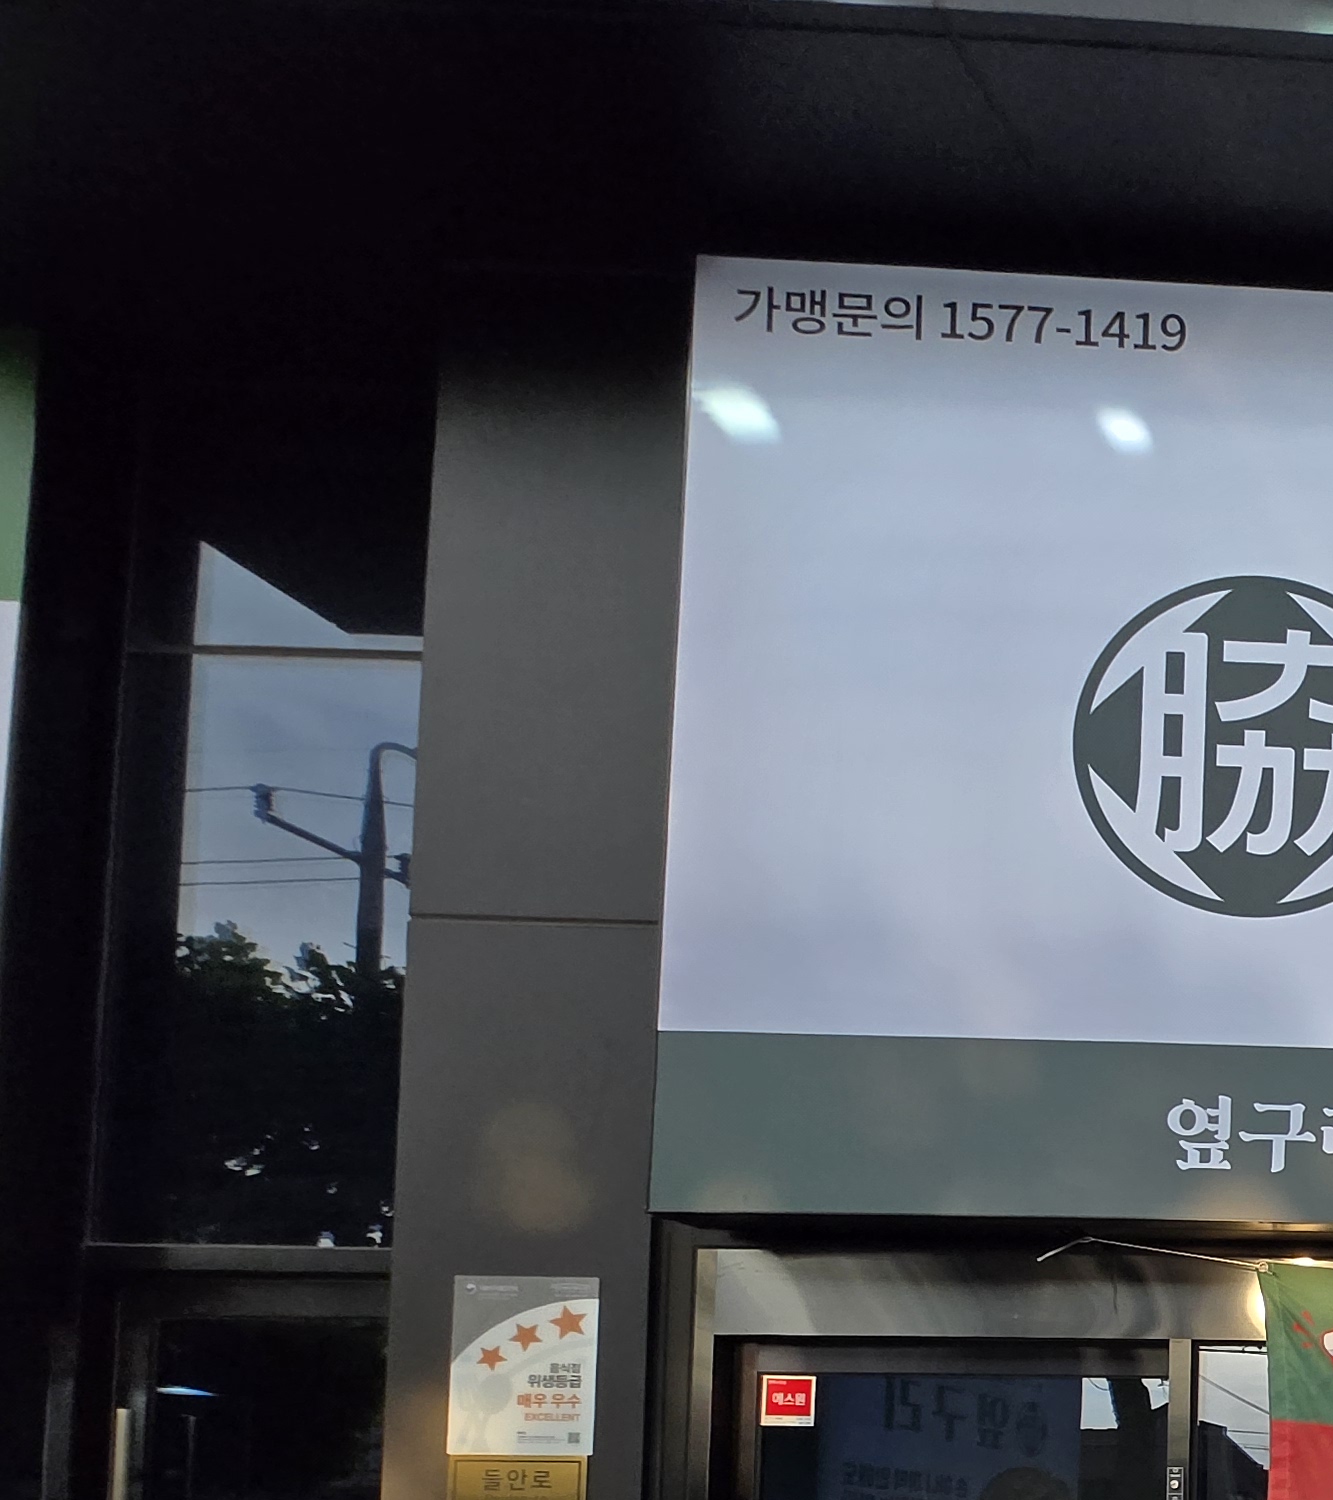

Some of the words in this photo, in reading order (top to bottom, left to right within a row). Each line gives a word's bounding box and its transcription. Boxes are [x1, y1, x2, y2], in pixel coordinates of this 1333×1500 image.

[734, 286, 926, 342] 가맹문의
[939, 299, 1187, 352] 1577-1419
[528, 1374, 582, 1388] 위생등급
[551, 1393, 582, 1408] 우수
[482, 1469, 553, 1491] 들안로
